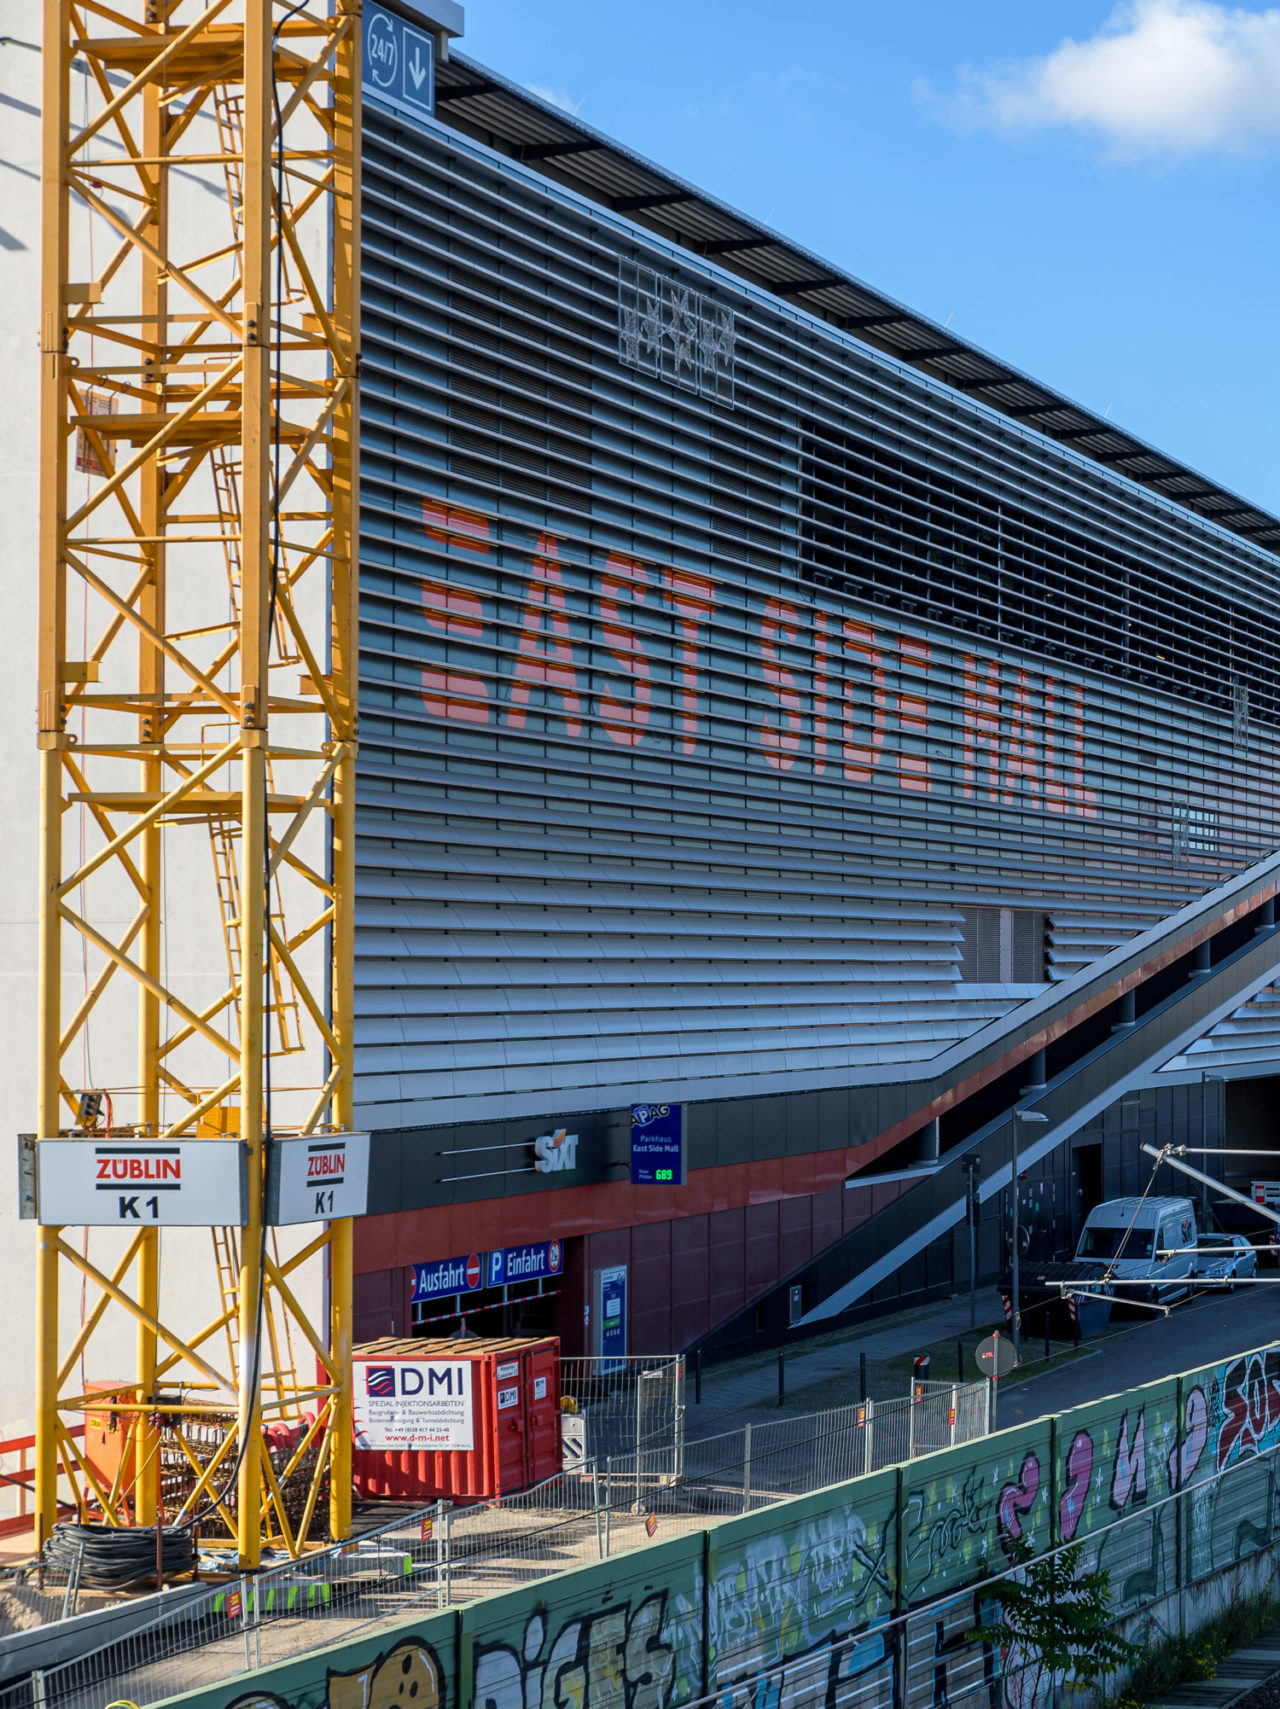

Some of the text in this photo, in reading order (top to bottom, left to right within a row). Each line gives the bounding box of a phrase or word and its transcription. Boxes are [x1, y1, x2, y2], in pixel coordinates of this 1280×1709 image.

[371, 33, 394, 66] 24/7
[421, 498, 1098, 818] EAST SIDE MALL
[633, 1144, 679, 1153] East Side Mall
[640, 1135, 672, 1143] Parkhaus
[535, 1128, 579, 1174] SIXT
[96, 1158, 181, 1180] ZÜBLIN
[307, 1153, 346, 1178] ZÜBLIN
[655, 1168, 673, 1180] 689
[119, 1196, 140, 1218] K
[491, 1247, 545, 1282] P Einfahrt
[419, 1263, 464, 1294] Ausfahrt
[401, 1367, 464, 1396] DMI
[395, 1400, 464, 1408] INJEKTIONSARBEITEN
[385, 1433, 450, 1442] www.d-m-i.net
